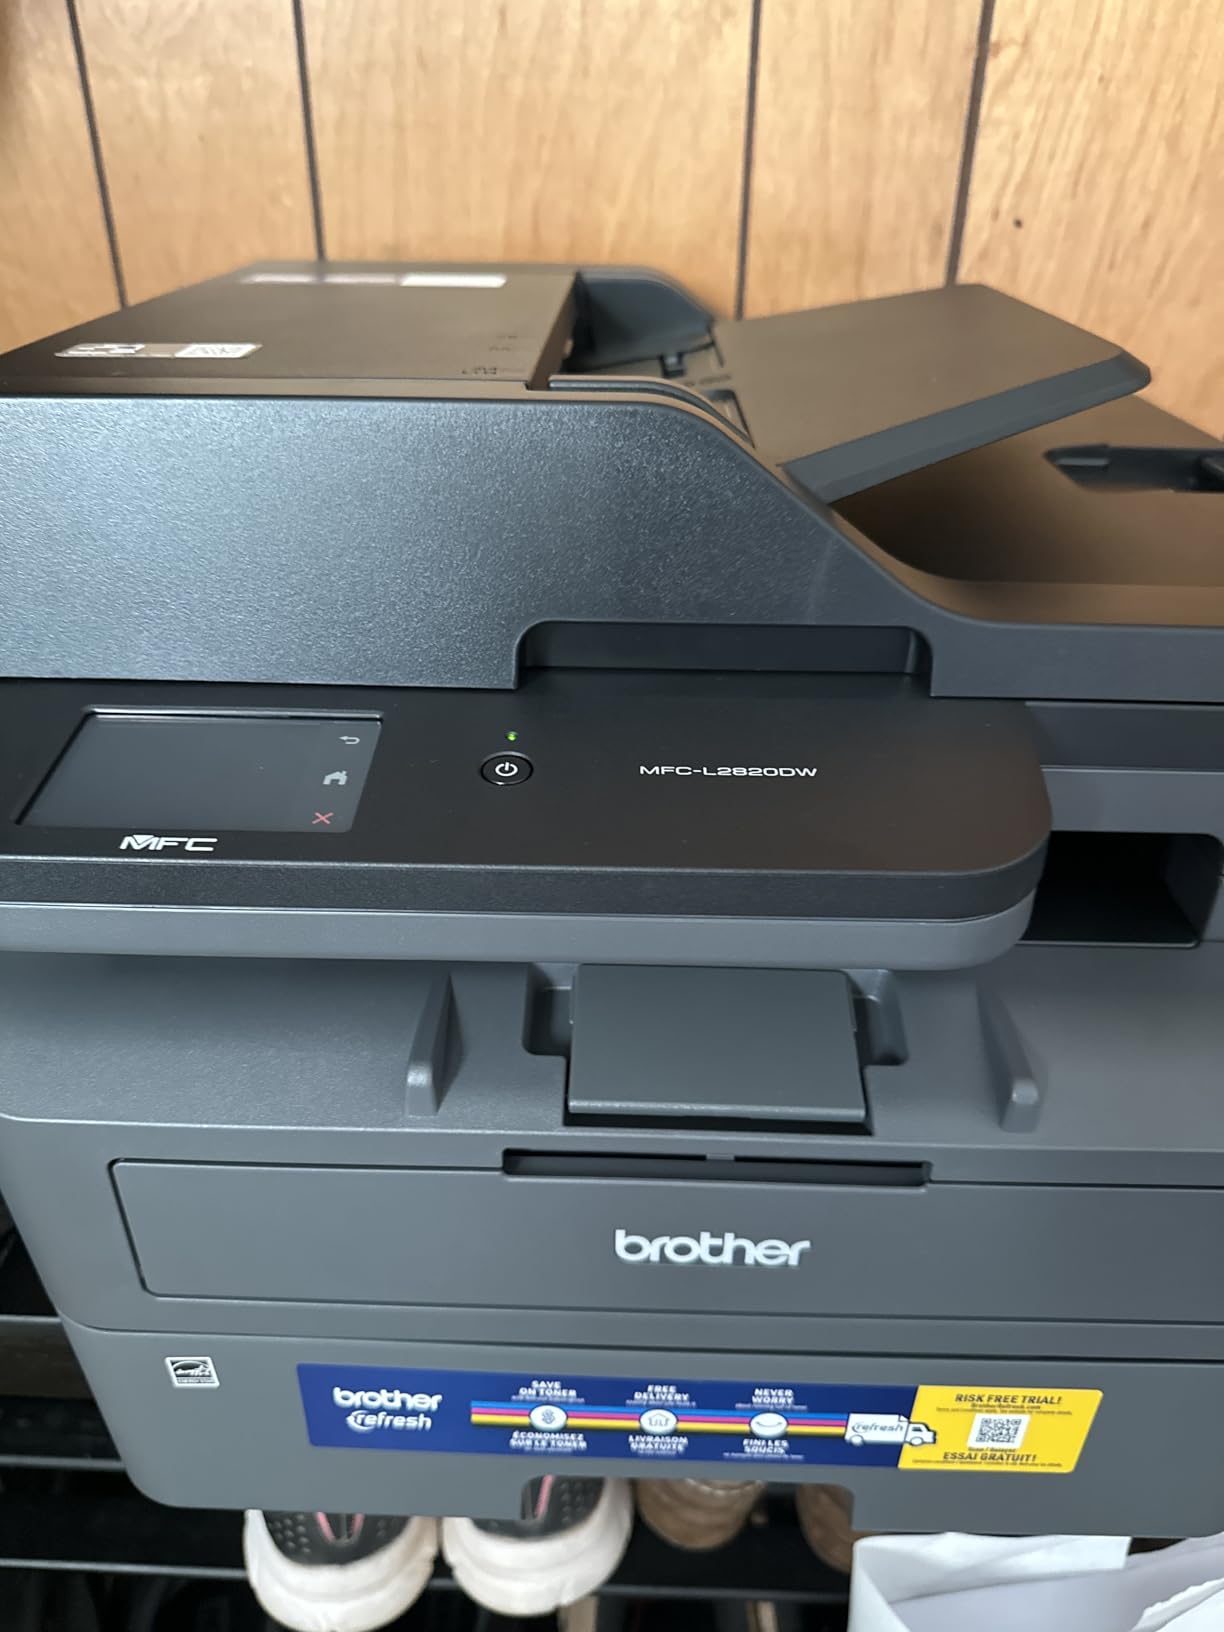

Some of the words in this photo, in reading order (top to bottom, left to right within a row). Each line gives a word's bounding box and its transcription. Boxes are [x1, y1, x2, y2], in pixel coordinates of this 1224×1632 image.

[639, 765, 818, 777] MFC-L2820DW
[120, 834, 219, 852] MFC
[615, 1229, 811, 1266] brother
[531, 1380, 561, 1389] SAVE
[647, 1384, 677, 1393] FREE
[519, 1387, 537, 1396] ON
[539, 1388, 577, 1398] TONER
[634, 1392, 689, 1402] DELIVERY
[754, 1388, 794, 1397] NEVER
[333, 1386, 442, 1412] brother
[752, 1396, 794, 1405] WORRY
[955, 1393, 984, 1402] RISK
[986, 1394, 1019, 1404] FREE
[1022, 1395, 1062, 1405] TRIAL!
[346, 1409, 433, 1433] refresh
[852, 1422, 904, 1434] refresh
[943, 1451, 977, 1461] ESSAI
[980, 1452, 1037, 1463] GRATUIT!
